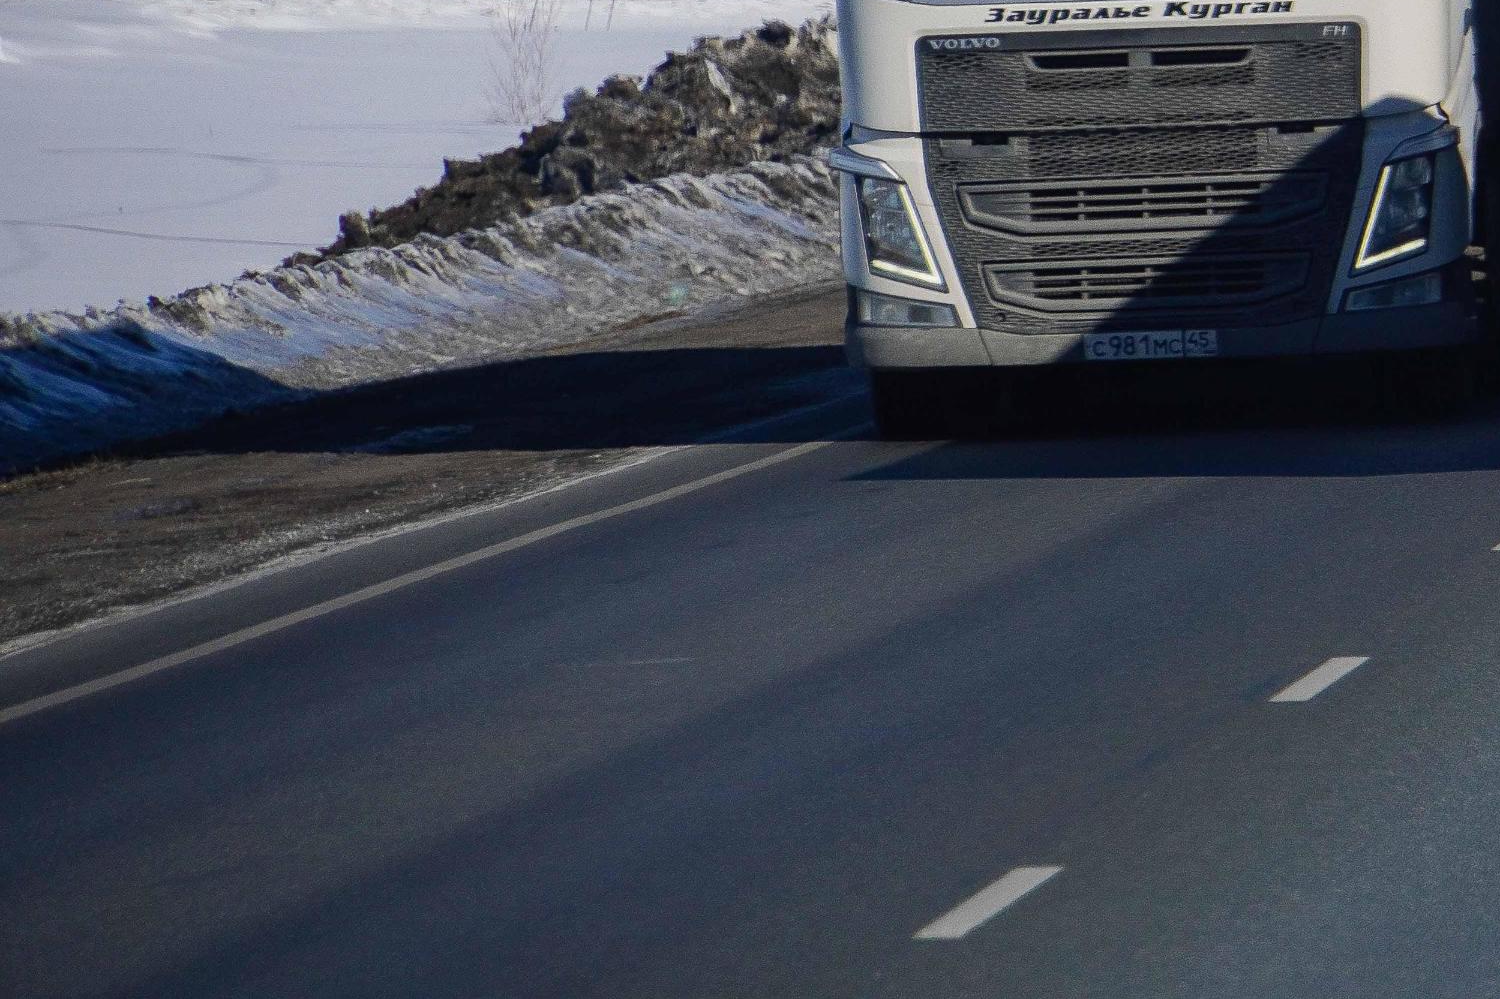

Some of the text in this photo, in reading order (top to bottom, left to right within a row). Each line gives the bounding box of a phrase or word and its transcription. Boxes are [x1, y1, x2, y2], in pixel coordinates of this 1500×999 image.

[984, 1, 1152, 25] Зауралье
[1322, 24, 1348, 37] FH
[929, 35, 1001, 51] VOLVO
